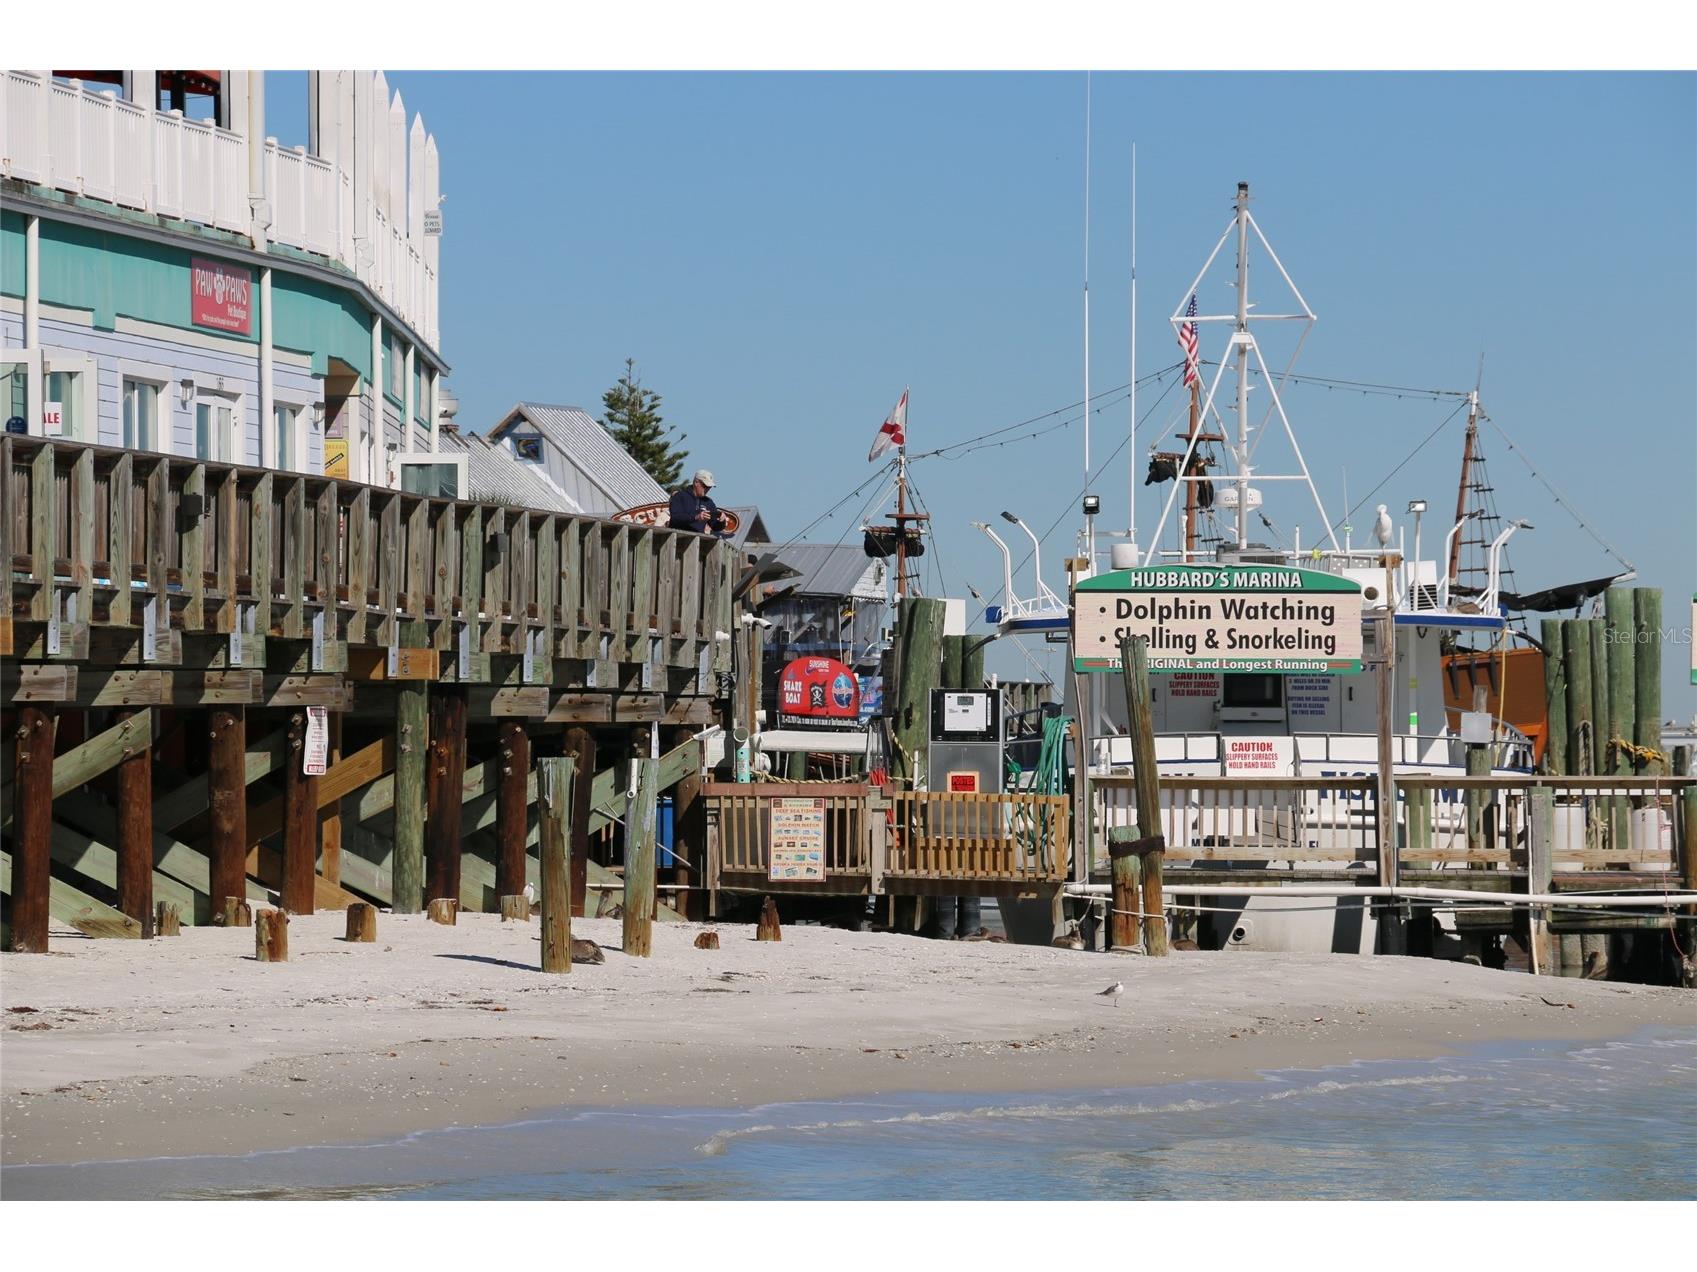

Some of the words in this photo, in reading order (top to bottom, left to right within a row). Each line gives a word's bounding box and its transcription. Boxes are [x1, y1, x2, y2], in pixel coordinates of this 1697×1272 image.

[195, 267, 214, 297] PAW
[225, 275, 247, 306] PAWS
[1131, 571, 1230, 588] HUBBARD'S
[1233, 572, 1303, 588] MARINA
[1116, 597, 1211, 625] Dolphin
[1220, 597, 1335, 626] Watching
[1204, 628, 1220, 649] &
[1227, 627, 1336, 656] Snorkeling
[1146, 658, 1193, 669] RIGINAL
[1196, 658, 1220, 669] and
[1222, 659, 1272, 672] Longest
[1275, 659, 1328, 672] Running
[1174, 672, 1216, 680] CAUTION
[785, 692, 801, 704] BOAT
[1171, 689, 1185, 697] HOLD
[1186, 689, 1201, 697] HAND
[1201, 689, 1217, 697] RAILS
[1231, 742, 1273, 752] CAUTION
[1225, 753, 1250, 761] SLIPPERY
[1251, 753, 1279, 761] SURFACES
